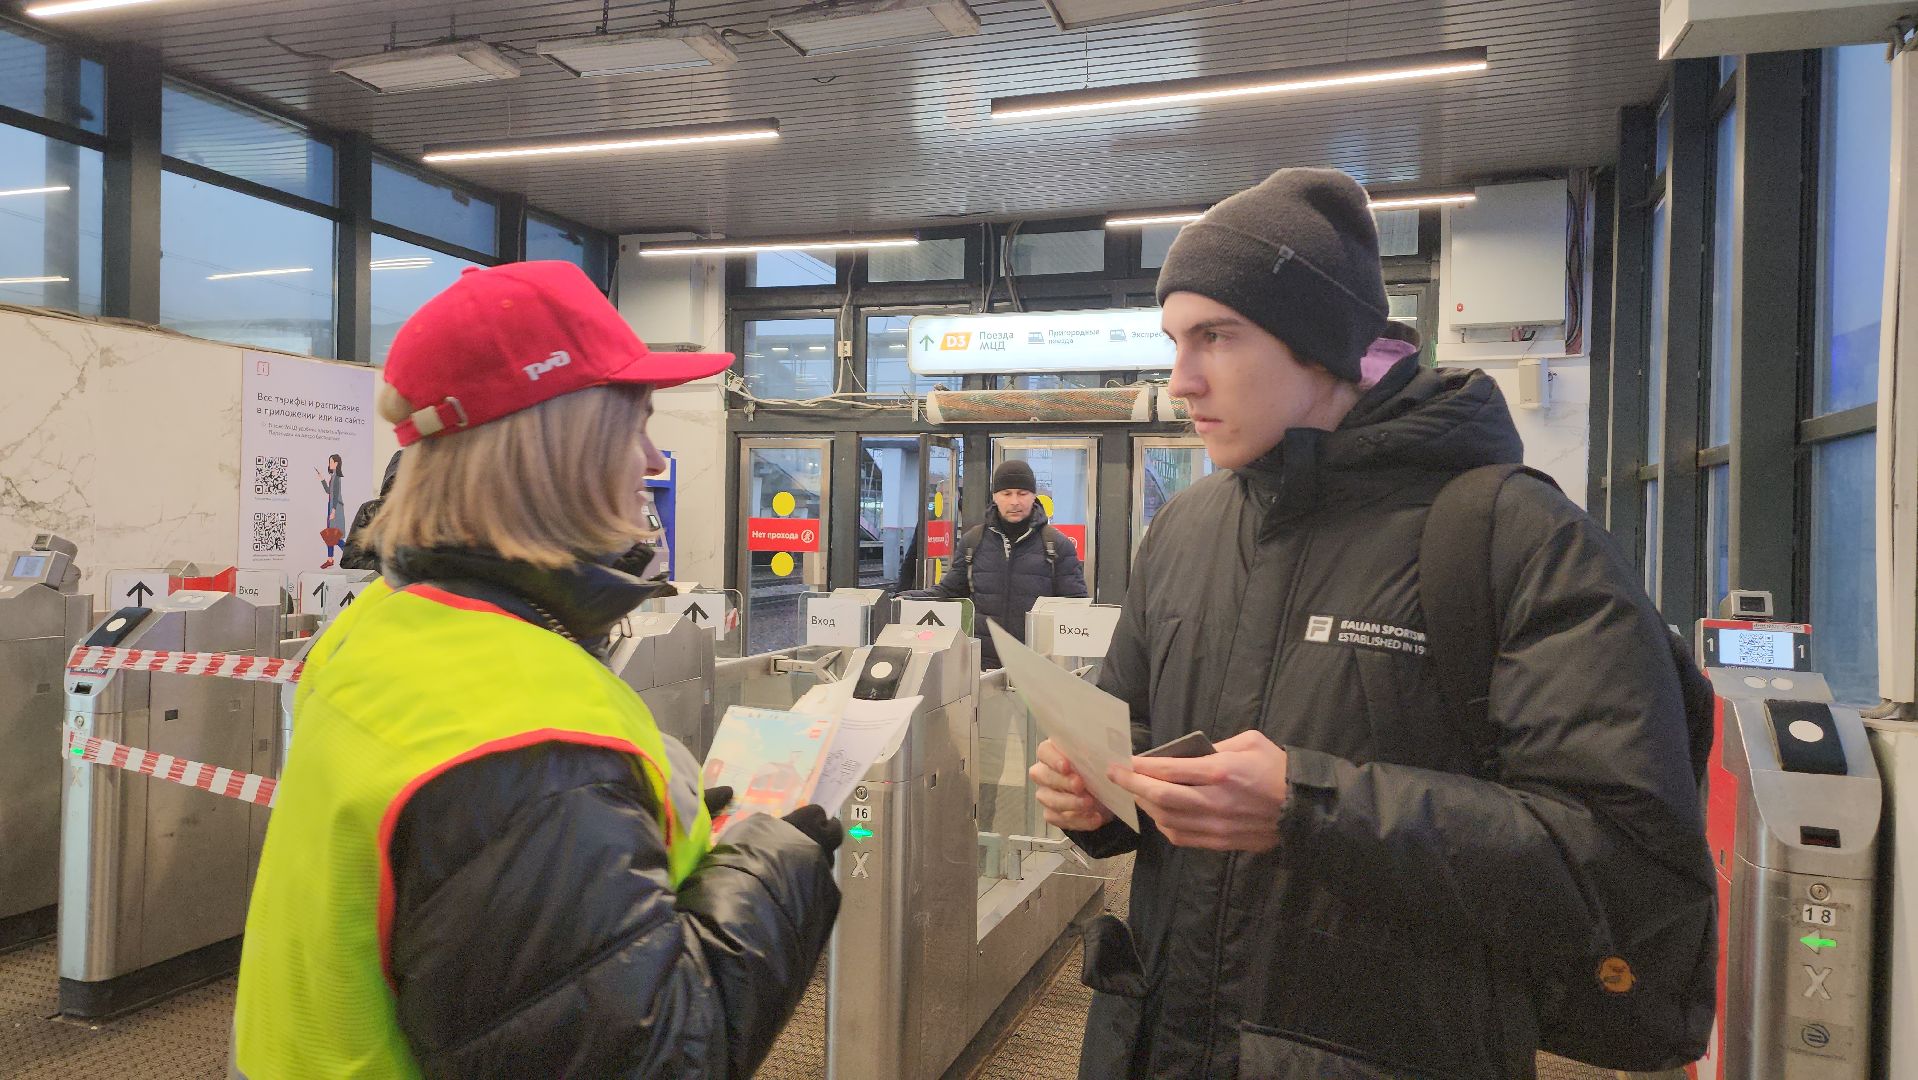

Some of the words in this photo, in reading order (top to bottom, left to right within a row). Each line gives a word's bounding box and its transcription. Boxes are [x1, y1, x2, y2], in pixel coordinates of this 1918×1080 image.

[946, 335, 967, 348] D3
[979, 331, 1014, 340] Поезда
[979, 341, 1006, 351] МЦД
[257, 392, 273, 402] Все
[275, 396, 307, 407] тарифы
[751, 530, 766, 539] Нет
[767, 532, 799, 540] прохода
[239, 585, 259, 597] Вход
[811, 615, 836, 628] Вход
[1059, 624, 1090, 637] Вход
[1338, 632, 1402, 650] ESTABLISHED
[1402, 641, 1413, 653] IN
[1414, 645, 1425, 655] 19
[855, 807, 868, 819] 16
[1804, 907, 1832, 924] 18
